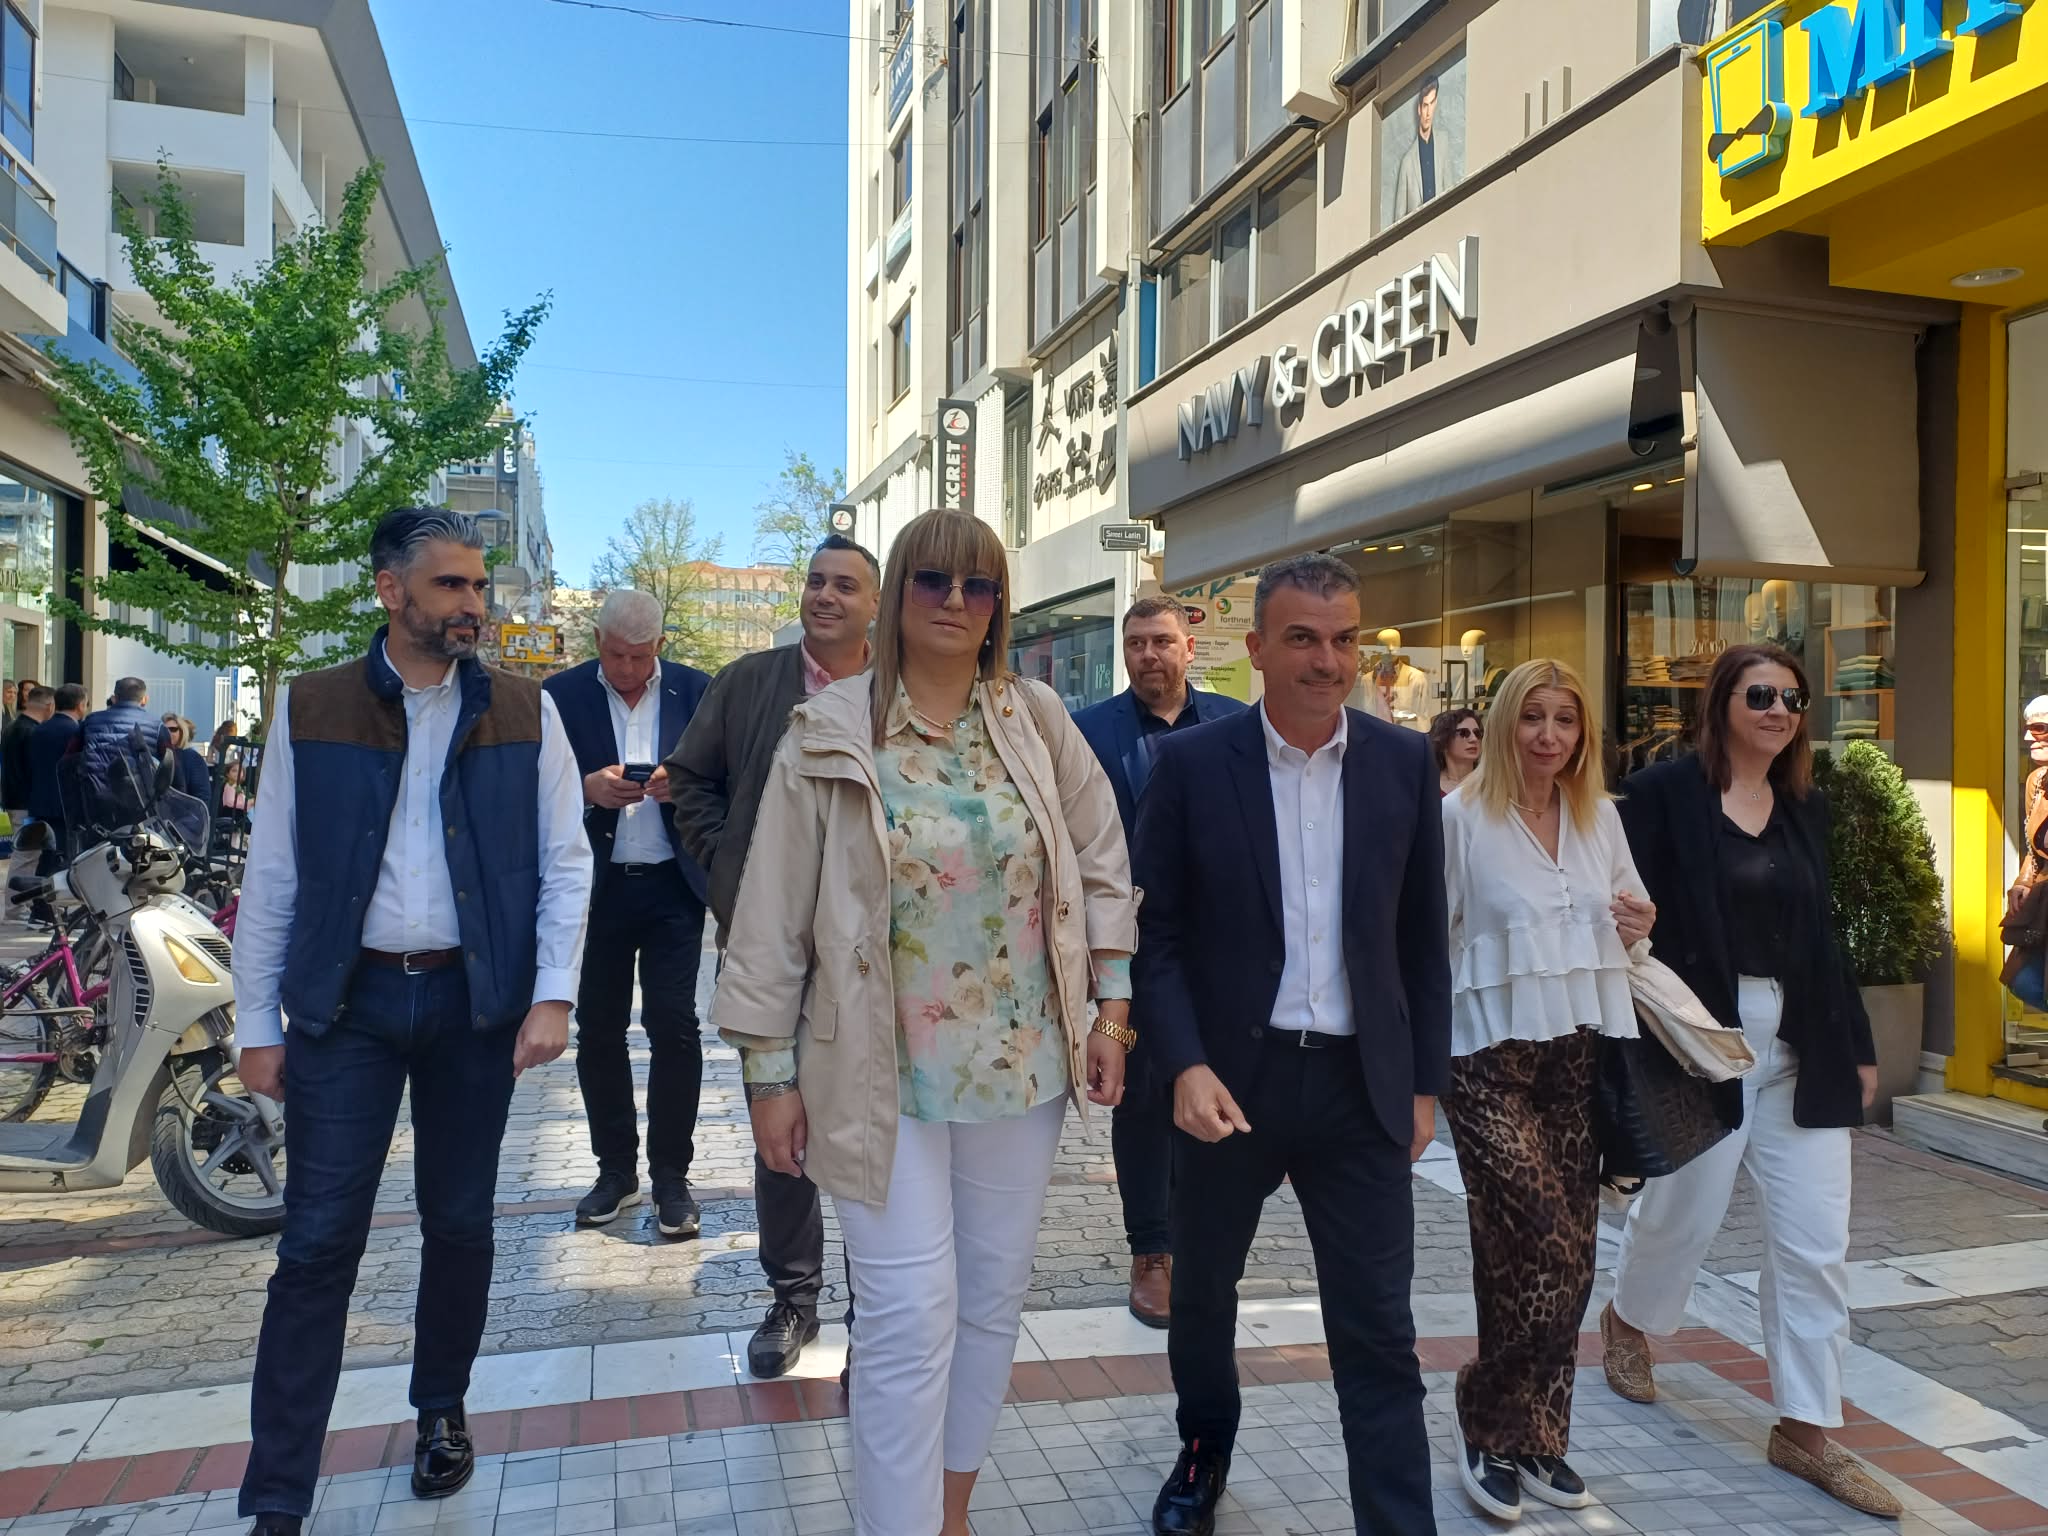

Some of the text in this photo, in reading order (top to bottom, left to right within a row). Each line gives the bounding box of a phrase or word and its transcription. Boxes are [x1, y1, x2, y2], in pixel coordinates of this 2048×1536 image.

[1178, 235, 1479, 461] NAVY & GREEN
[1220, 615, 1251, 624] forthnet
